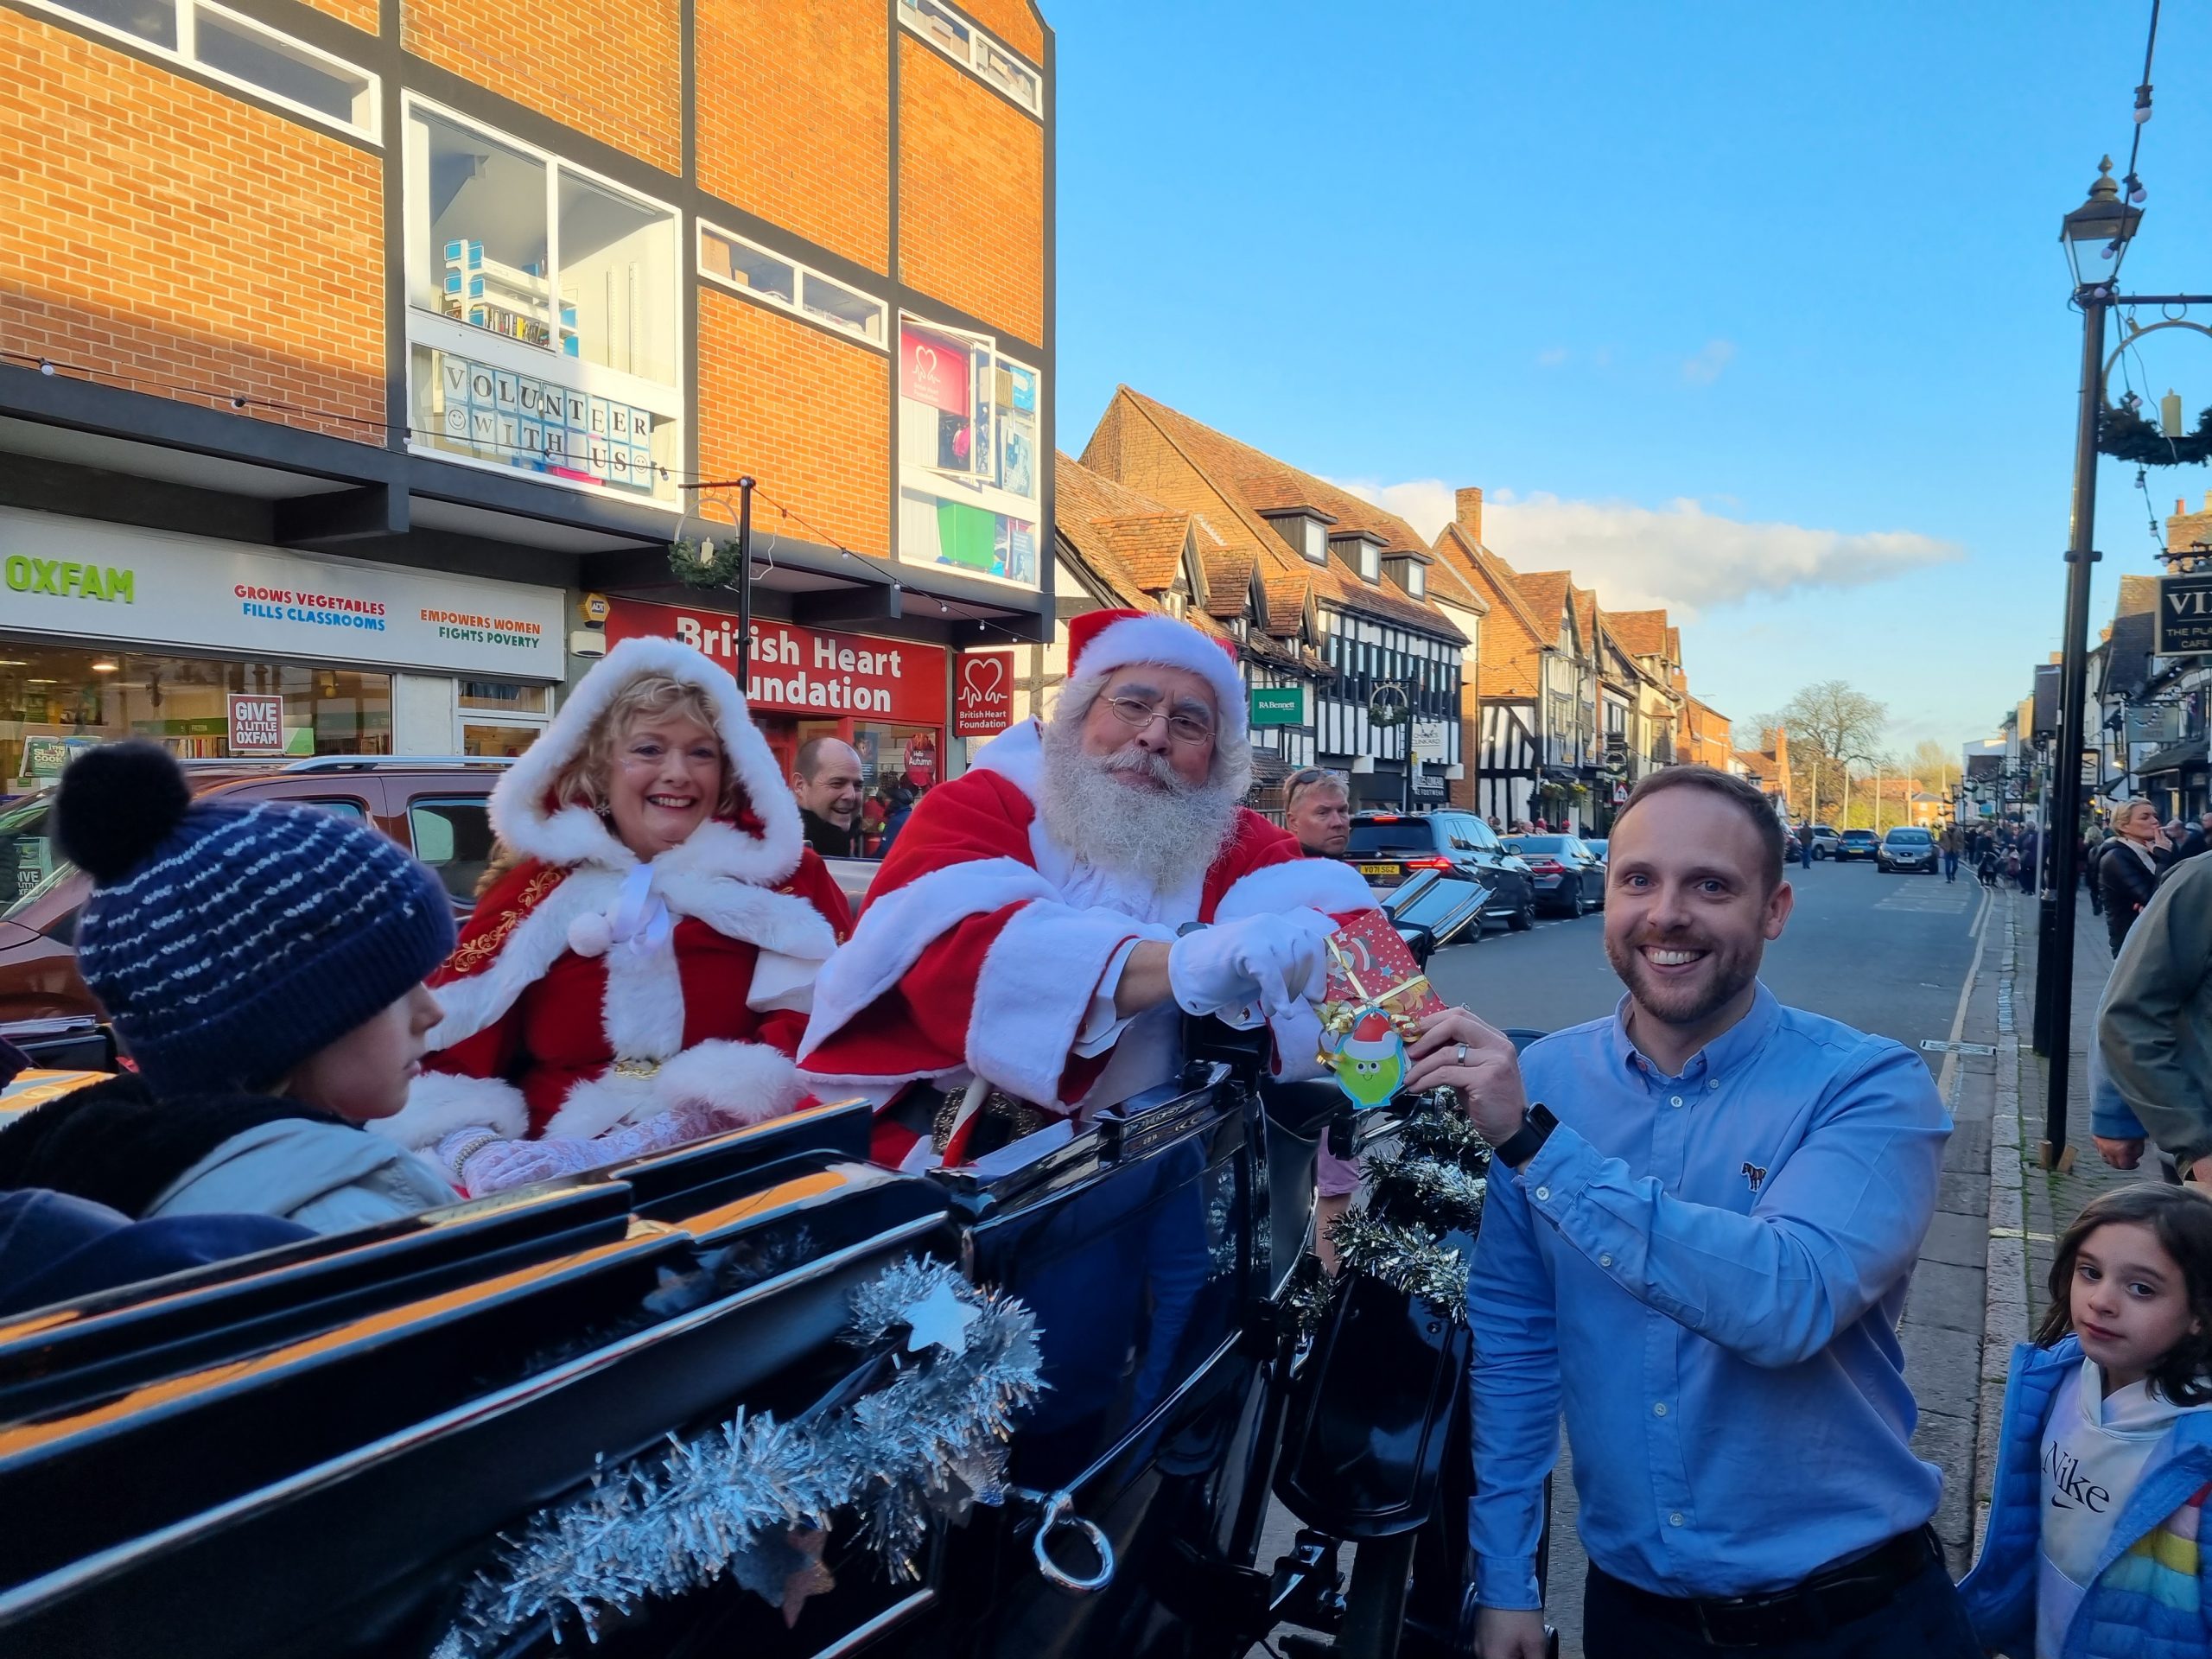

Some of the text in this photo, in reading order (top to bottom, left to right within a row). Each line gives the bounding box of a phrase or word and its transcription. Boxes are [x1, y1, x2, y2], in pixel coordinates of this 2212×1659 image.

[445, 366, 647, 435] VOLUNTEER
[474, 415, 626, 472] WITH US
[6, 554, 134, 604] OXFAM
[234, 584, 385, 616] GROWS VEGETABLES
[592, 602, 604, 611] ADT
[2166, 591, 2212, 614] VI
[243, 602, 385, 632] FILLS CLASSROOMS
[421, 609, 541, 634] EMPOWERS WOMEN
[439, 626, 540, 648] FIGHTS POVERTY
[2166, 627, 2189, 636] THE
[814, 636, 901, 678] Heart
[747, 671, 891, 712] undation
[235, 702, 277, 721] GIVE
[959, 710, 984, 719] British
[236, 721, 276, 732] A LITTLE
[959, 720, 1007, 728] Foundation
[237, 732, 277, 744] OXFAM
[17, 871, 40, 882] IVE
[2042, 1440, 2110, 1513] Nike
